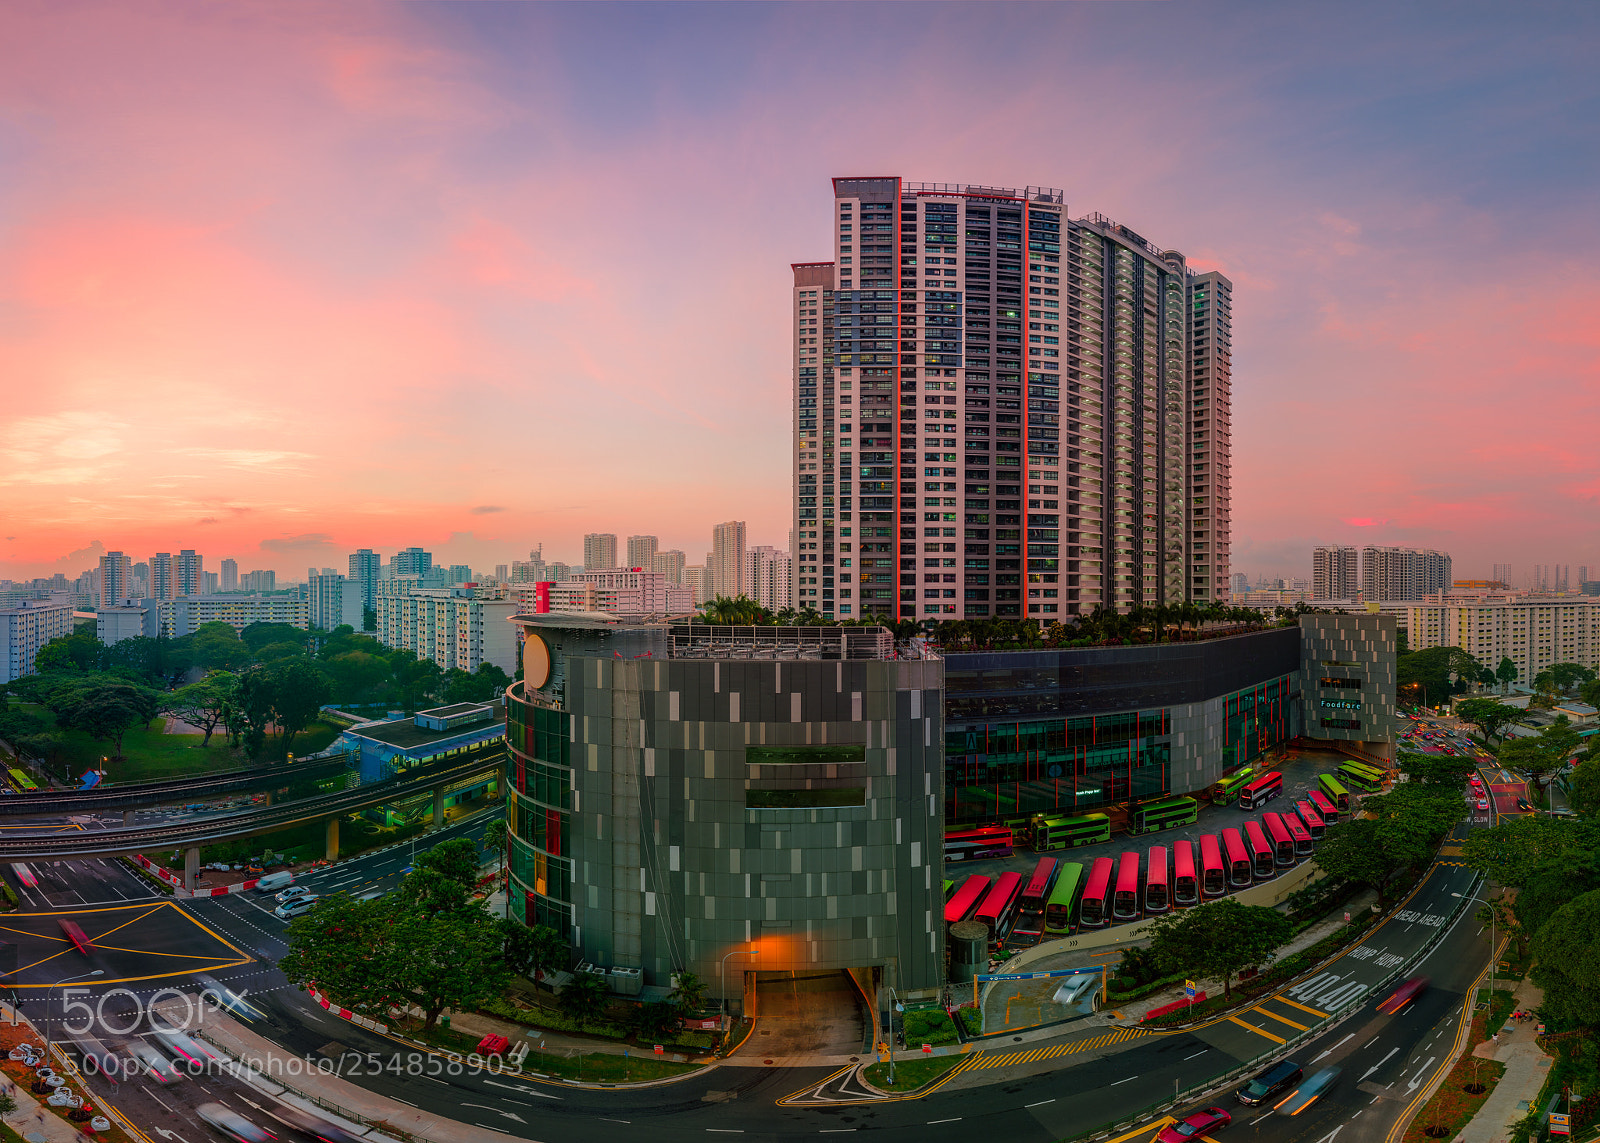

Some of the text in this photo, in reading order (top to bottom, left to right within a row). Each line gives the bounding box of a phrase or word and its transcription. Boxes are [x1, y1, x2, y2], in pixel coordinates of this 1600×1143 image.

[1392, 909, 1446, 927] AHEAD AHEAD
[1347, 945, 1404, 968] HUMP HUMP
[1288, 972, 1369, 1011] 40 40
